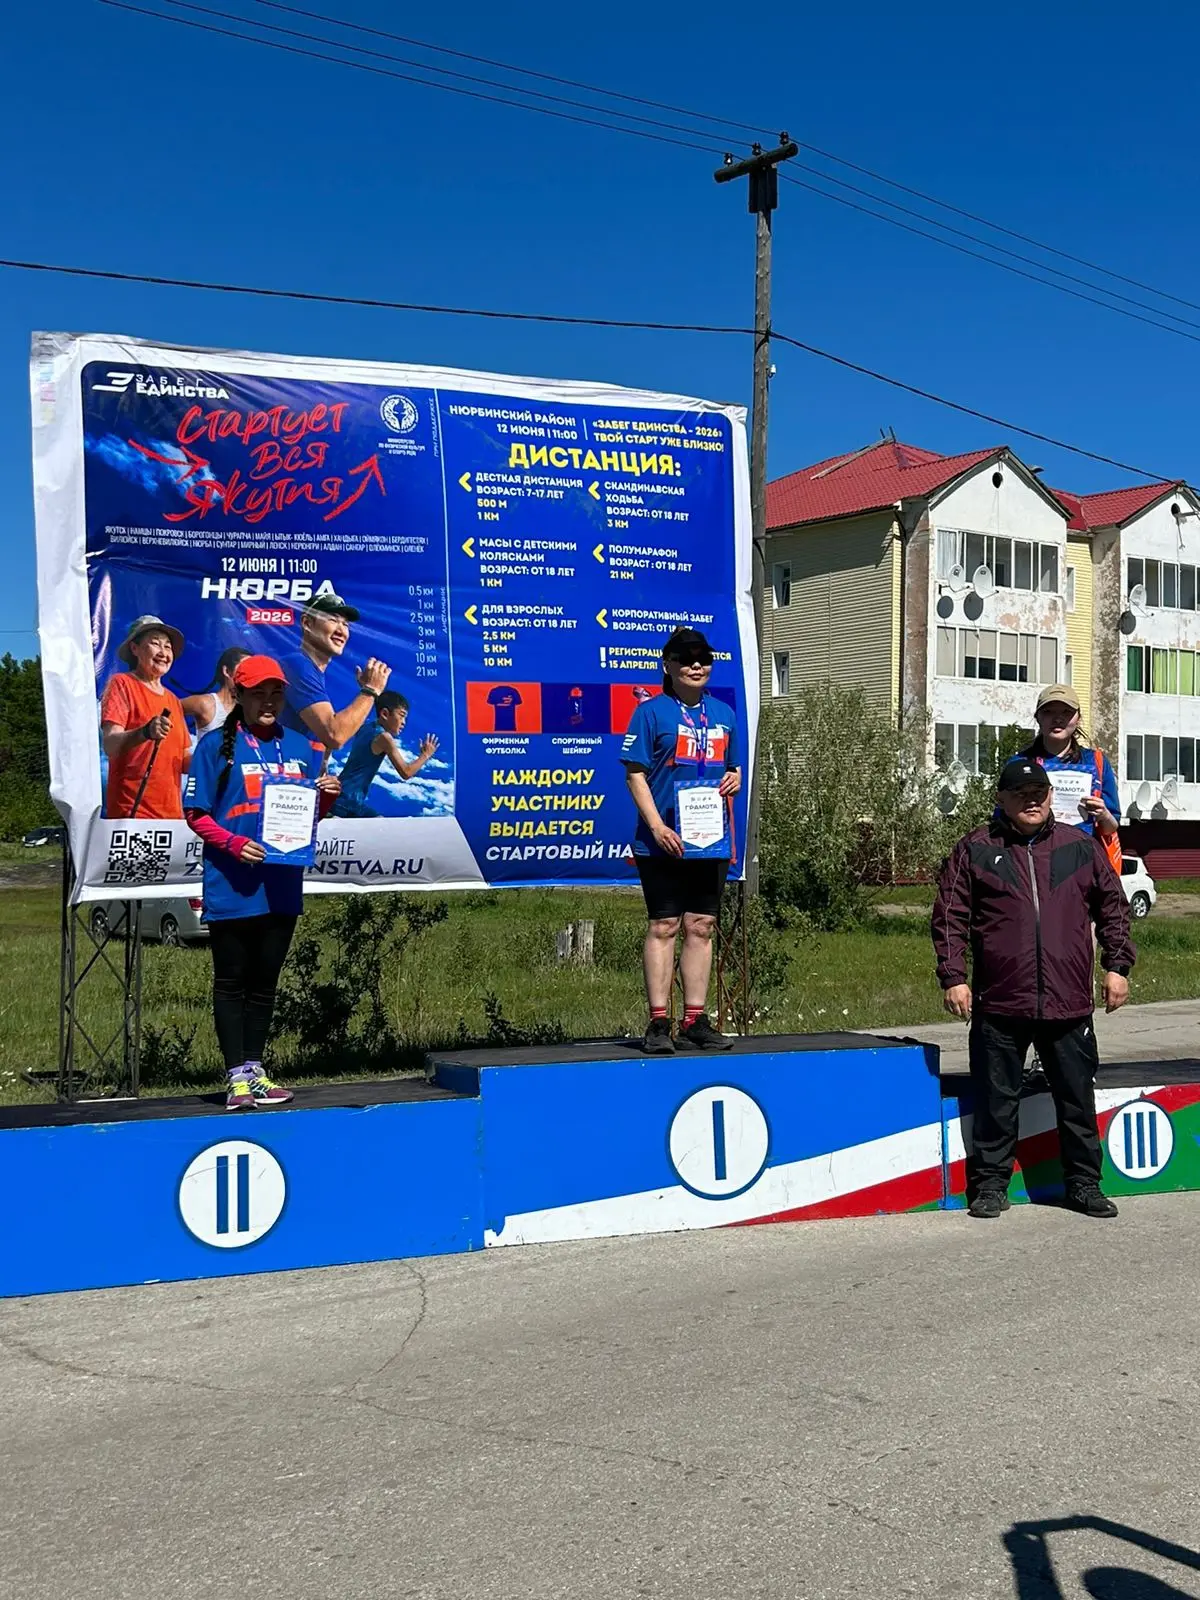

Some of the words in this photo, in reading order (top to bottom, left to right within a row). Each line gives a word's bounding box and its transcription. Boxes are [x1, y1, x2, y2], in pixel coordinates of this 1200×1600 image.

[136, 373, 204, 387] ЗАБЕГ
[136, 383, 229, 400] ЕДИНСТВА
[449, 405, 533, 422] НЮРБИНСКИЙ
[534, 413, 576, 427] РАЙОН!
[496, 423, 508, 434] 12
[510, 424, 545, 438] ИЮНЯ
[552, 429, 578, 440] 11:00
[592, 419, 631, 431] «ЗАБЕГ
[632, 421, 687, 435] ЕДИНСТВА
[593, 432, 624, 443] ТВОЙ
[625, 434, 658, 446] СТАРТ
[659, 436, 681, 448] УЖЕ
[683, 440, 725, 453] БЛИЗКО!
[509, 442, 681, 477] ДИСТАНЦИЯ:
[475, 472, 521, 483] ДЕСТКАЯ
[523, 475, 583, 488] ДИСТАНЦИЯ
[476, 485, 525, 497] ВОЗРАСТ:
[526, 488, 545, 498] 7-17
[546, 490, 564, 499] ЛЕТ
[604, 481, 685, 496] СКАНДИНАВСКАЯ
[477, 498, 497, 508] 500
[499, 499, 508, 508] М
[605, 494, 644, 505] ХОДЬБА
[477, 512, 482, 520] 1
[484, 512, 499, 521] КМ
[606, 506, 650, 518] ВОЗРАСТ:
[651, 509, 663, 519] ОТ
[664, 511, 673, 520] 18
[674, 512, 689, 522] ЛЕТ
[607, 519, 613, 527] 3
[615, 520, 629, 528] КМ
[479, 538, 512, 548] МАСЫ
[513, 539, 522, 548] С
[523, 540, 577, 551] ДЕТСКИМИ
[480, 551, 545, 562] КОЛЯСКАМИ
[608, 544, 678, 558] ПОЛУМАРАФОН
[221, 557, 236, 572] 12
[239, 558, 277, 573] ИЮНЯ
[288, 559, 318, 574] 11:00
[480, 565, 530, 575] ВОЗРАСТ:
[531, 566, 544, 575] ОТ
[545, 567, 555, 576] 18
[557, 567, 575, 577] ЛЕТ
[655, 561, 668, 570] ОТ
[668, 562, 676, 571] 18
[677, 563, 692, 572] ЛЕТ
[610, 570, 619, 579] 21
[620, 571, 634, 580] КМ
[480, 579, 485, 587] 1
[486, 579, 503, 588] КМ
[201, 577, 335, 602] НЮРБА
[481, 604, 504, 615] ДЛЯ
[506, 605, 564, 615] ВЗРОСЛЫХ
[250, 610, 292, 623] 2026
[612, 609, 689, 621] КОРПОРАТИВНЫЙ
[690, 614, 714, 623] ЗАБЕГ
[482, 618, 532, 628] ВОЗРАСТ:
[533, 619, 546, 628] ОТ
[548, 619, 557, 628] 18
[559, 620, 577, 629] ЛЕТ
[612, 622, 655, 632] ВОЗРАСТ:
[656, 624, 668, 632] ОТ
[418, 626, 424, 637] 3
[483, 631, 498, 641] 2,5
[500, 631, 516, 640] КМ
[418, 639, 424, 650] 5
[483, 645, 489, 653] 5
[492, 645, 508, 653] КМ
[415, 652, 425, 663] 10
[483, 658, 494, 666] 10
[497, 658, 512, 666] КМ
[609, 660, 618, 668] 15
[619, 660, 658, 670] АПРЕЛЯ!
[416, 666, 426, 677] 21
[482, 736, 529, 745] ФИРМЕННАЯ
[551, 736, 602, 745] СПОРТИВНЫЙ
[485, 747, 527, 755] ФУТБОЛКА
[562, 745, 592, 755] ШЕЙКЕР
[492, 769, 594, 788] КАЖДОМУ
[271, 802, 309, 811] ГРАМОТА
[491, 794, 605, 812] УЧАСТНИКУ
[685, 803, 718, 811] ГРАМОТА
[489, 820, 594, 839] ВЫДАЕТСЯ
[485, 840, 604, 861] СТАРТОВЫЙ
